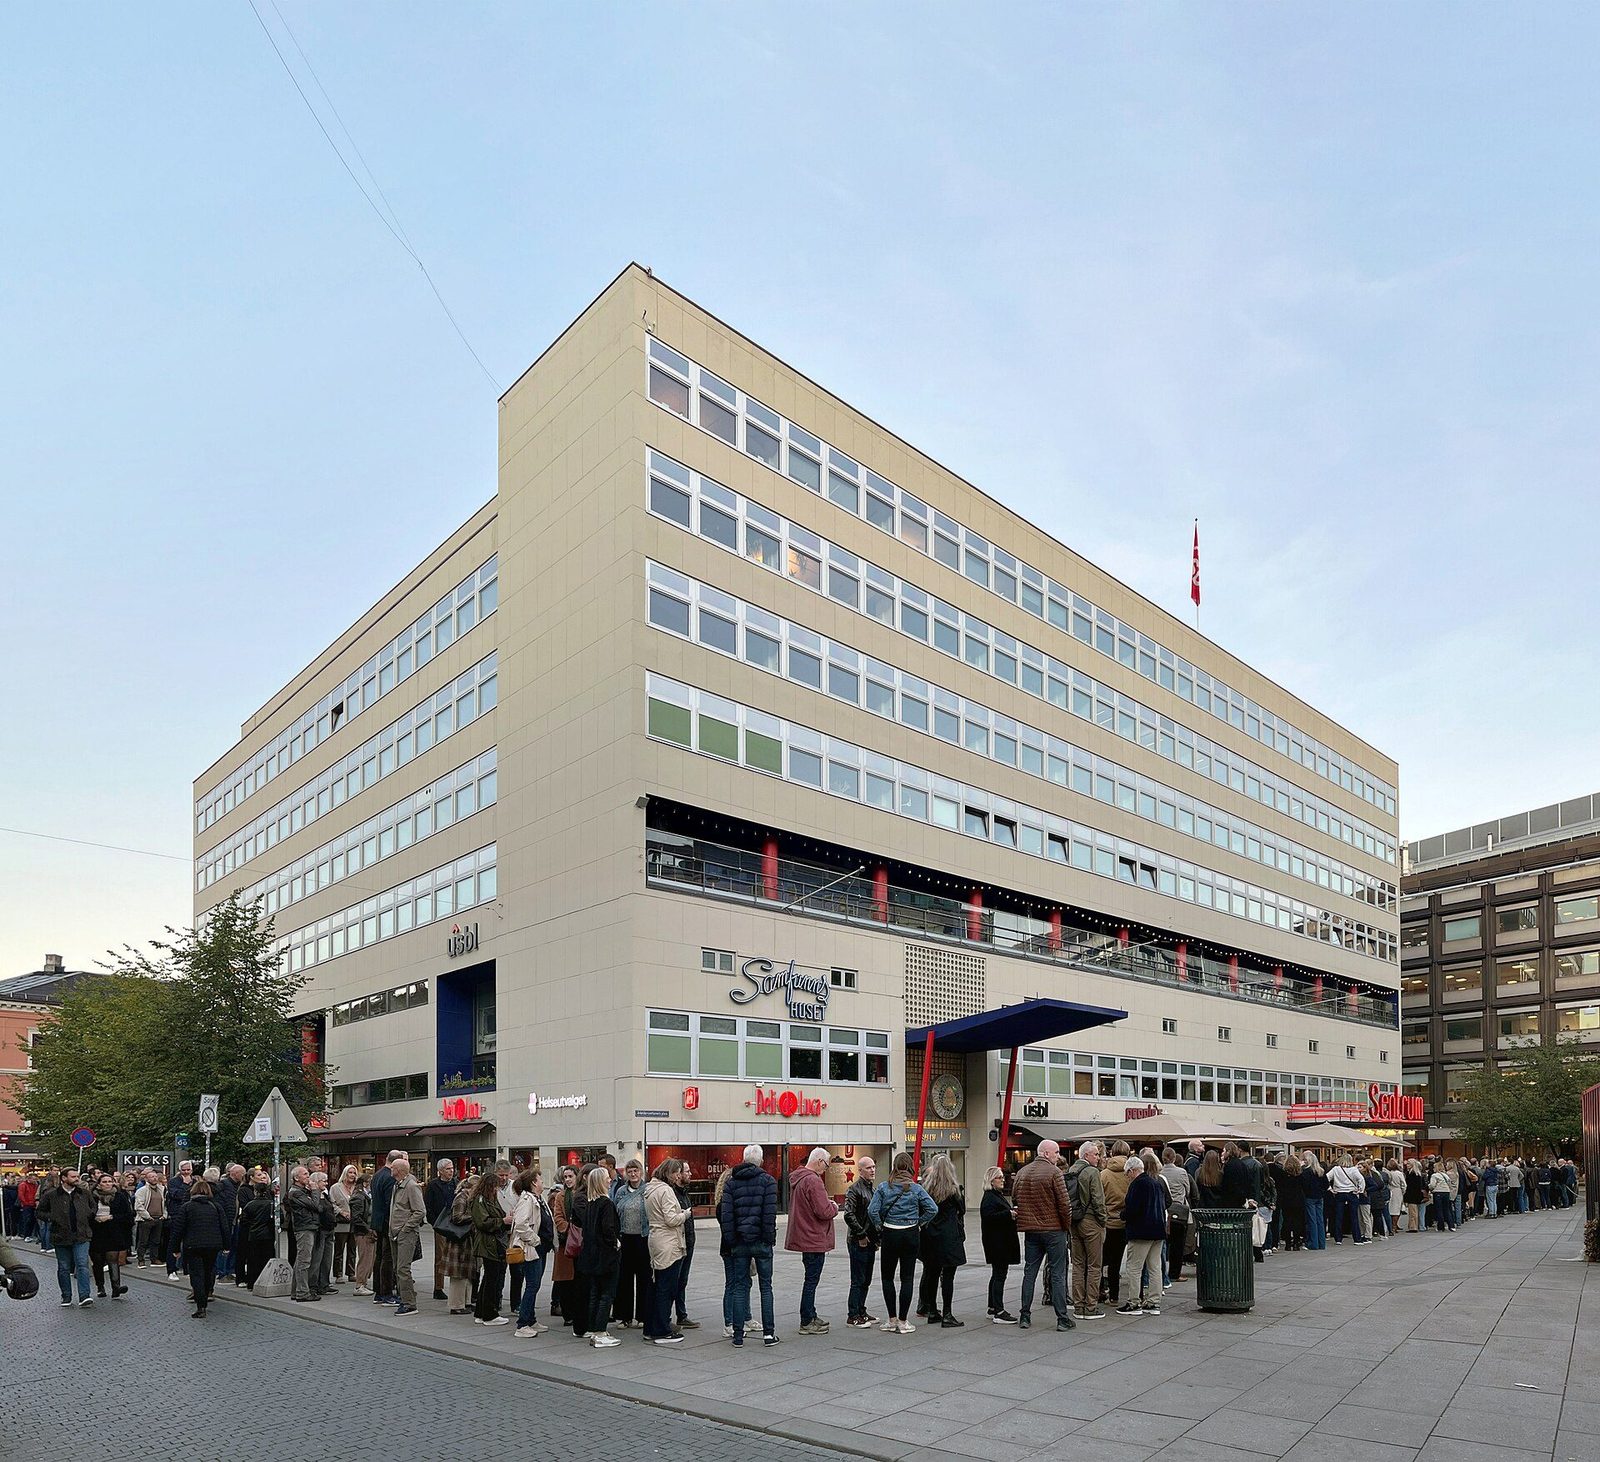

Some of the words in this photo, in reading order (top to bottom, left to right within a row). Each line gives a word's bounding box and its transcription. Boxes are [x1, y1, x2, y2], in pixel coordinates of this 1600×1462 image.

[729, 956, 830, 1007] Samfunns
[790, 1001, 828, 1021] HUSET
[538, 1094, 586, 1109] Helseutvalget
[1368, 1082, 1425, 1121] Sentrum
[123, 1155, 170, 1165] KICKS
